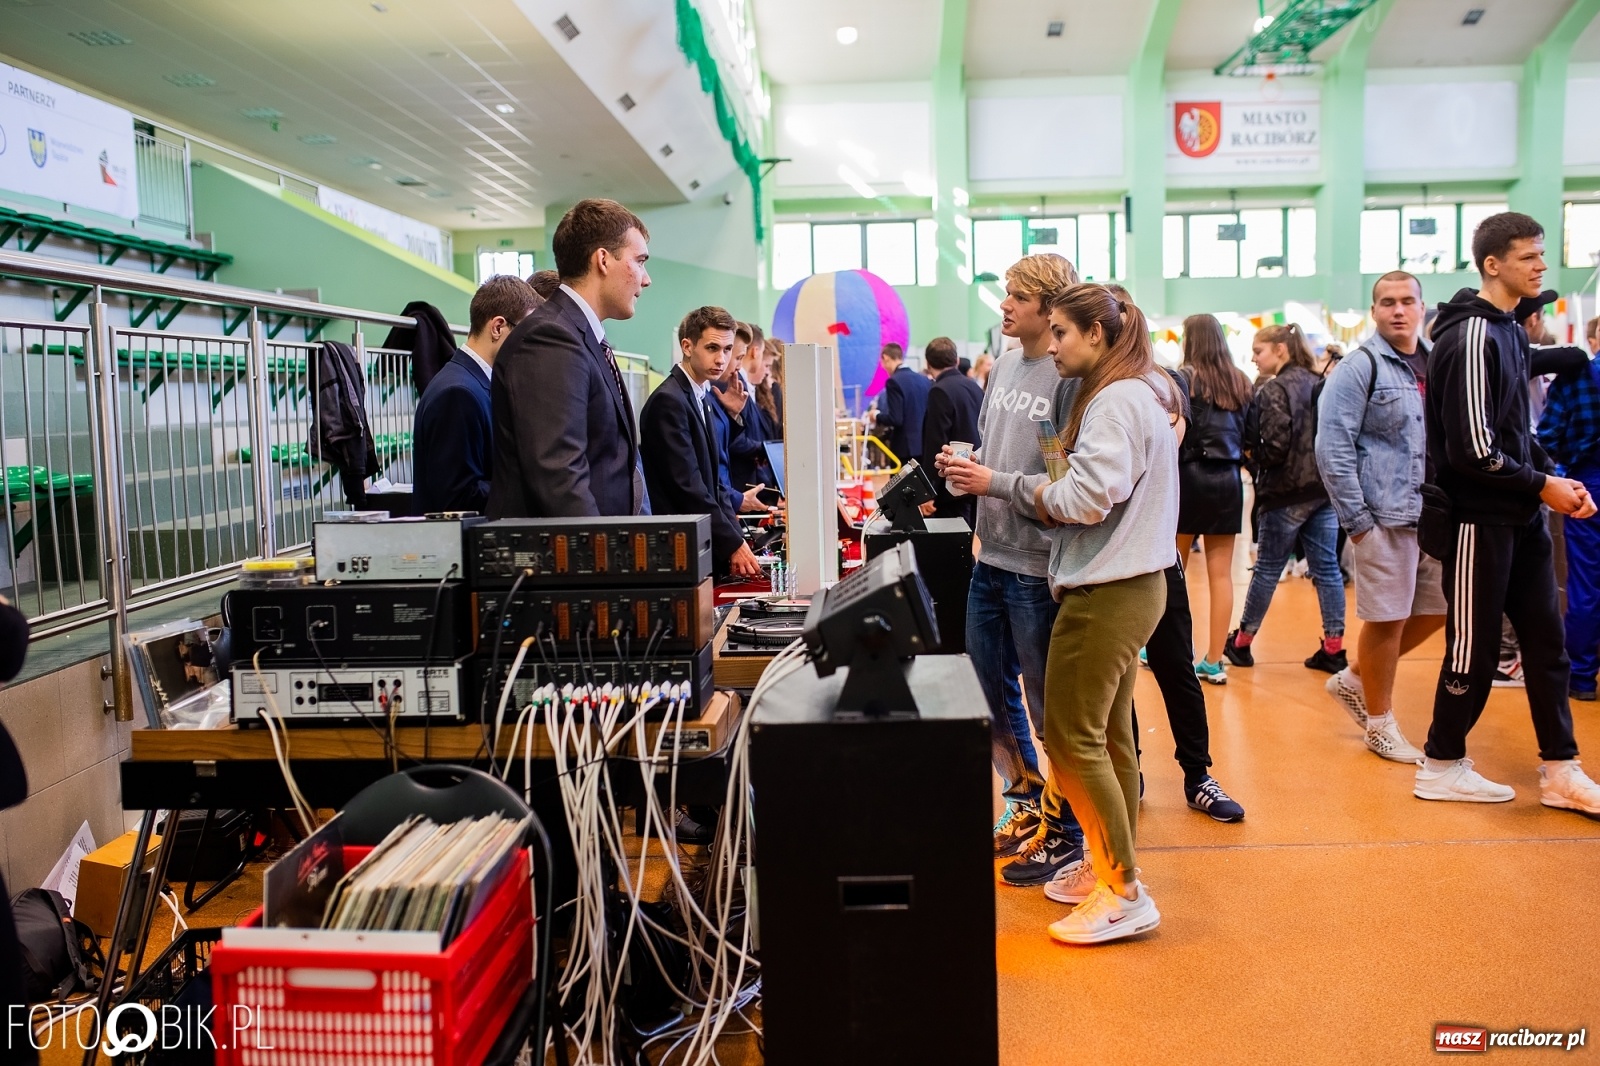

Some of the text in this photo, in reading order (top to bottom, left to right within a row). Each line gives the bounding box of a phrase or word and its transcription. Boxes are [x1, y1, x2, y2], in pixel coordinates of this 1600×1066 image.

[8, 81, 56, 109] PARTNERZY
[1242, 110, 1307, 126] MIASTO
[1231, 129, 1317, 146] RACIBÓRZ
[989, 386, 1050, 418] ROPP
